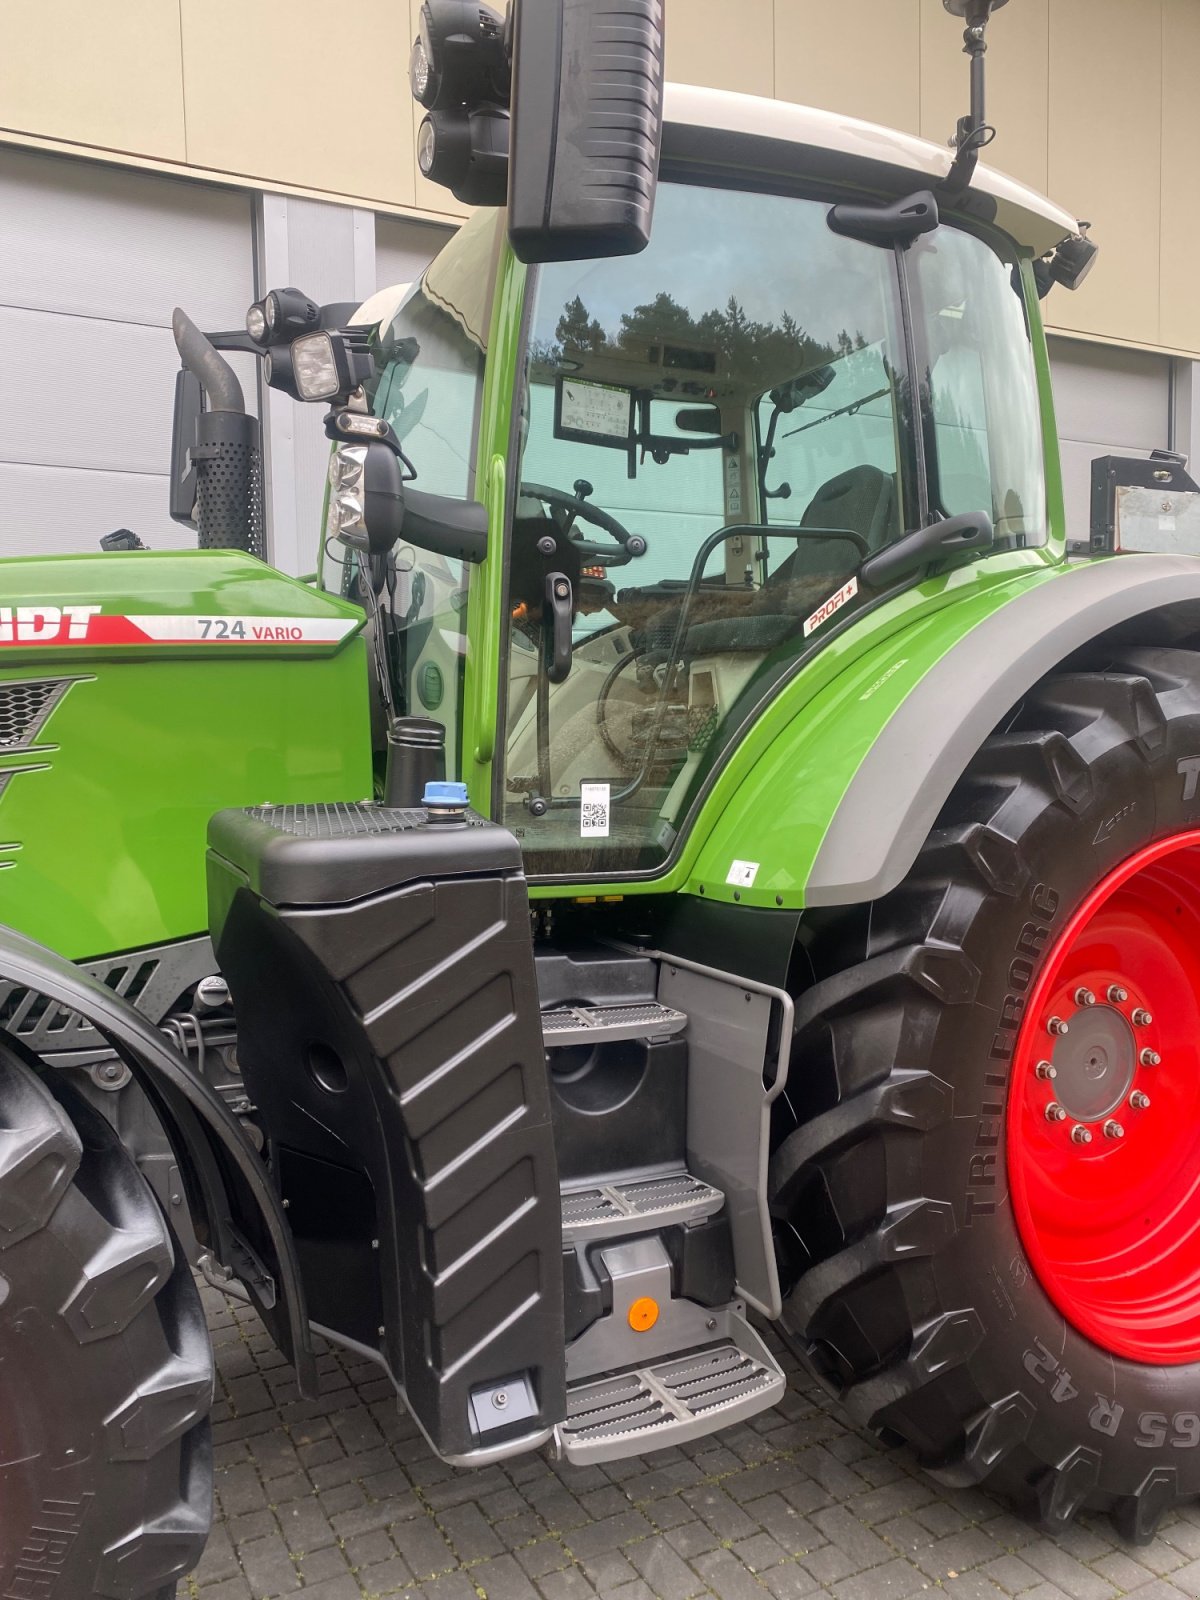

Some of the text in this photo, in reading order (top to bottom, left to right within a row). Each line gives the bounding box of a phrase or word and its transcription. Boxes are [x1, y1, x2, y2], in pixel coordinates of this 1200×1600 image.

[198, 619, 303, 640] 724 VARIO
[964, 882, 1059, 1228] TRELLEBORG
[1022, 1335, 1078, 1404] 42
[1088, 1391, 1124, 1437] R
